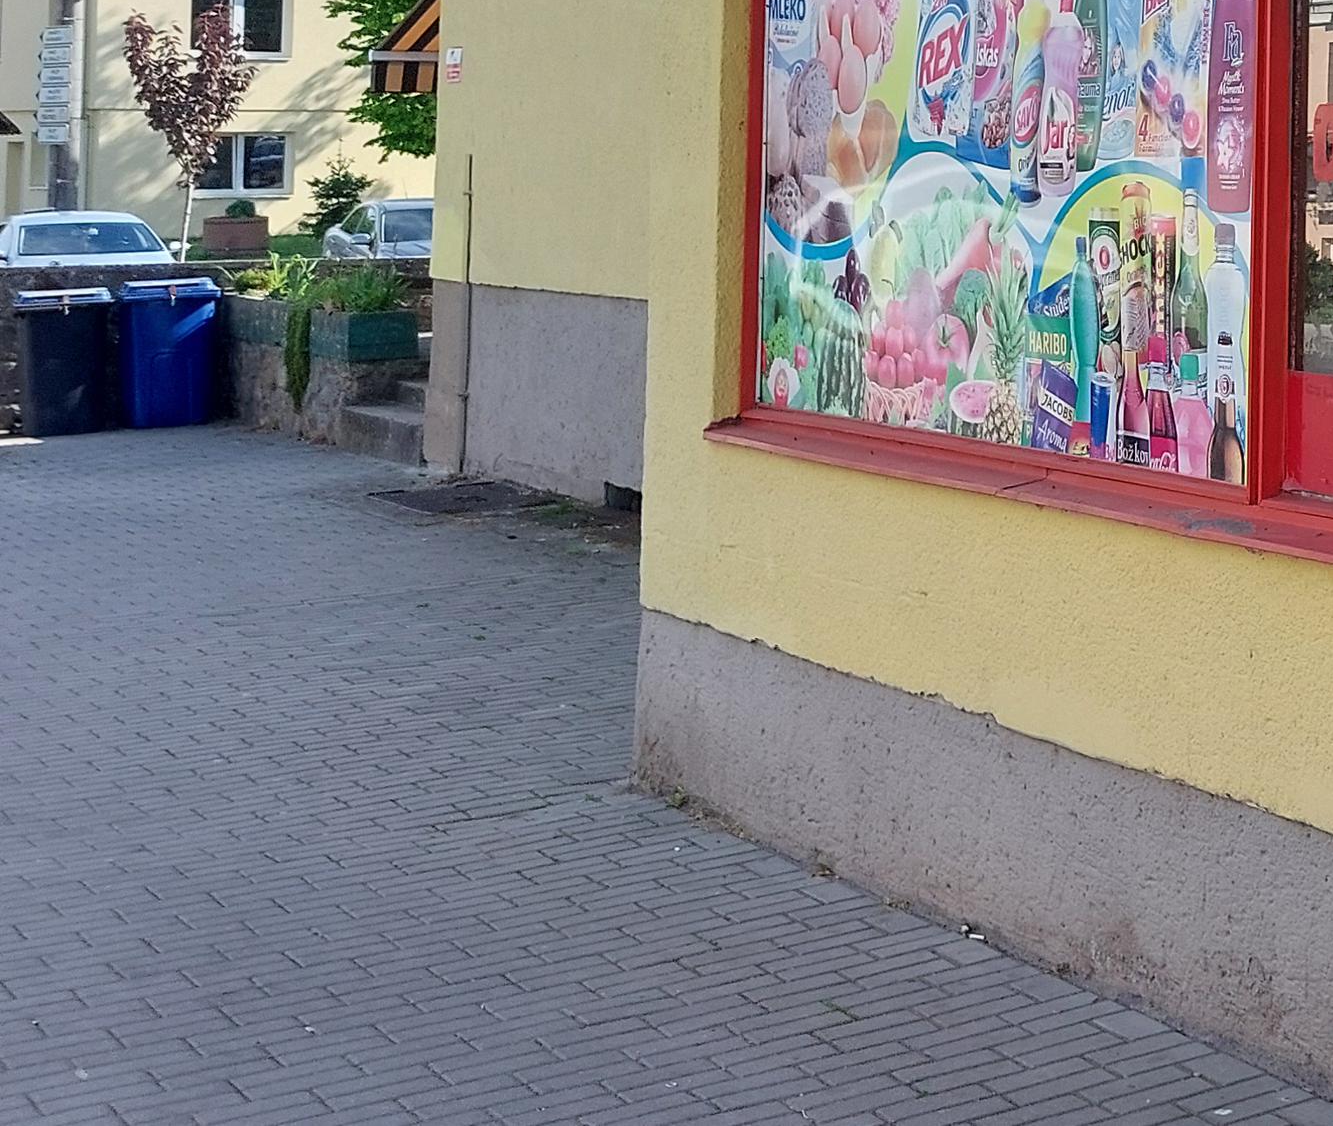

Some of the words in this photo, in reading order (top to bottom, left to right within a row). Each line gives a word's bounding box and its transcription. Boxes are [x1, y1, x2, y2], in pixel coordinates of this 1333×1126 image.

[919, 15, 969, 90] REX
[976, 44, 999, 68] iskas
[1103, 83, 1134, 115] enor
[1138, 113, 1149, 142] 4
[1028, 329, 1067, 357] HARIBO
[1040, 392, 1074, 423] JACOBS
[1036, 420, 1067, 453] Aroma
